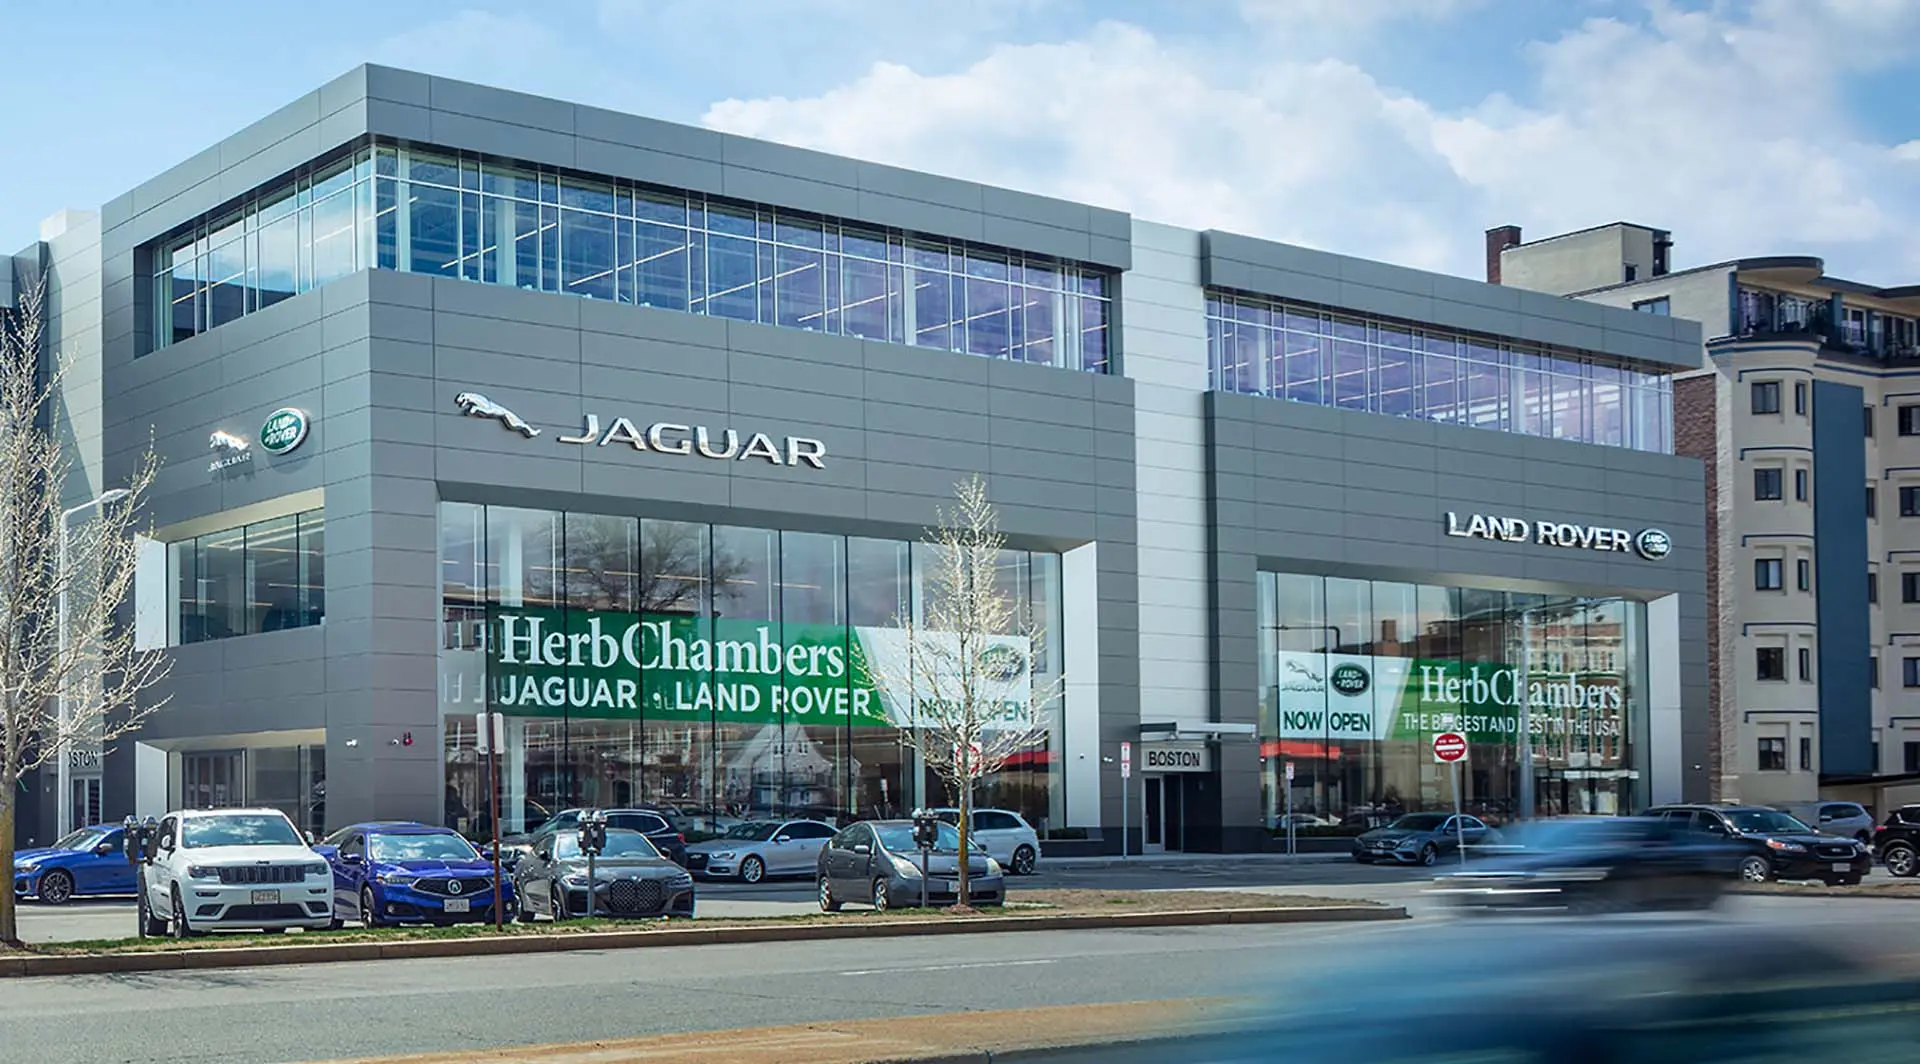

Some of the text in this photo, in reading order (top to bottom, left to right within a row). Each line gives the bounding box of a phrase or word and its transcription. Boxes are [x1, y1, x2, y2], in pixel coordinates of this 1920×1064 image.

[556, 414, 826, 468] JAGUAR
[1445, 512, 1631, 552] LAND ROVER
[501, 674, 872, 716] JAGUAR LAND ROVER
[1283, 711, 1371, 732] NOW OPEN
[1403, 713, 1429, 730] THE
[1432, 714, 1488, 732] BGEST
[1489, 716, 1516, 733] AND
[1518, 717, 1548, 734] EST
[68, 751, 98, 767] STON
[1149, 751, 1200, 766] BOSTON
